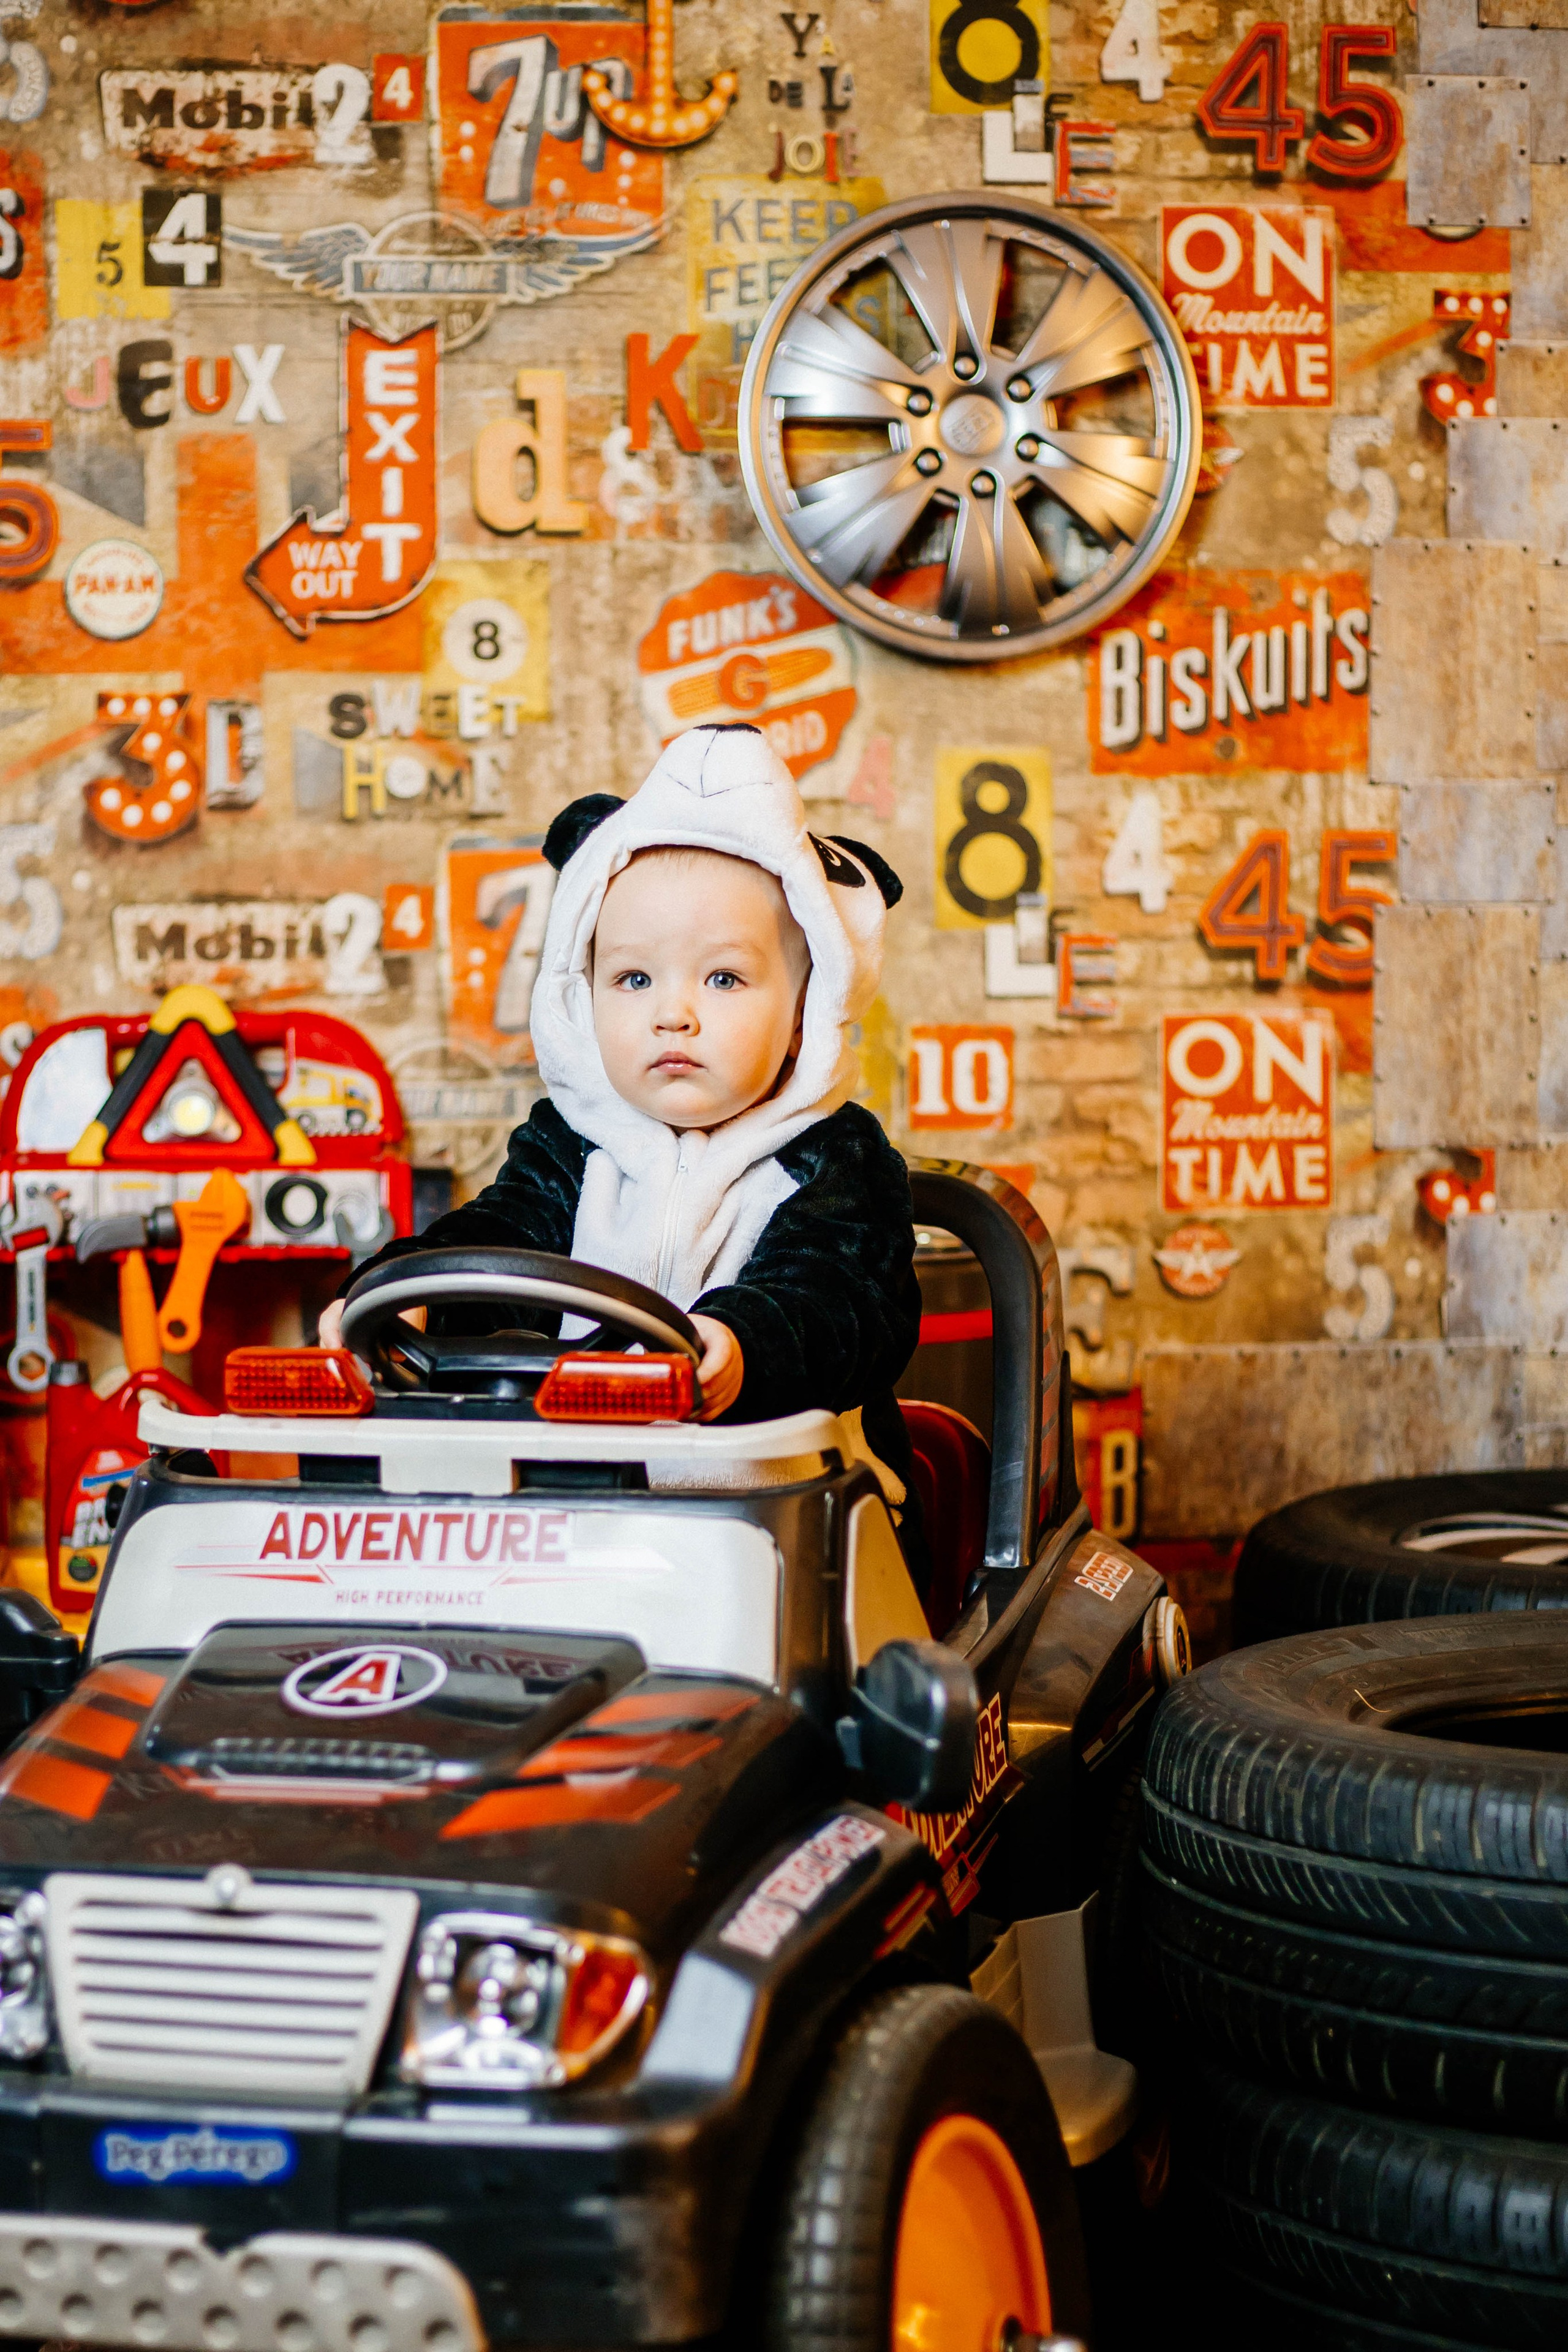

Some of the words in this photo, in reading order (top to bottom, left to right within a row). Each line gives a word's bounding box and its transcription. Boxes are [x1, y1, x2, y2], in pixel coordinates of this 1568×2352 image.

[313, 63, 371, 164] 2
[384, 67, 414, 109] 4
[1197, 22, 1404, 176] 45
[96, 241, 123, 287] 5
[148, 192, 217, 285] 4
[1167, 212, 1325, 304] ON
[1171, 291, 1328, 336] Mountain
[63, 338, 287, 429] JEUX
[625, 331, 704, 452] K
[1187, 338, 1330, 399] IME
[361, 349, 422, 583] EXIT
[472, 369, 589, 534] d
[1325, 415, 1398, 547] 5
[287, 540, 364, 570] WAY
[290, 570, 358, 600] OUT
[471, 620, 501, 662] 8
[667, 584, 798, 662] FUNK'S
[717, 654, 772, 710] G
[1101, 585, 1372, 753] Biskuits
[84, 693, 202, 842] 3
[944, 761, 1042, 919] 8
[1104, 792, 1174, 914] 4
[323, 892, 383, 995] 2
[393, 894, 425, 938] 4
[1199, 830, 1399, 981] 45
[912, 1038, 1011, 1117] 10
[1167, 1014, 1324, 1106] ON
[1168, 1098, 1324, 1142] Mountain
[1167, 1142, 1327, 1203] TIME
[259, 1510, 570, 1563] ADVENTURE
[336, 1591, 369, 1606] HIGH
[375, 1590, 484, 1606] PERFORMANCE
[310, 1652, 401, 1705] A
